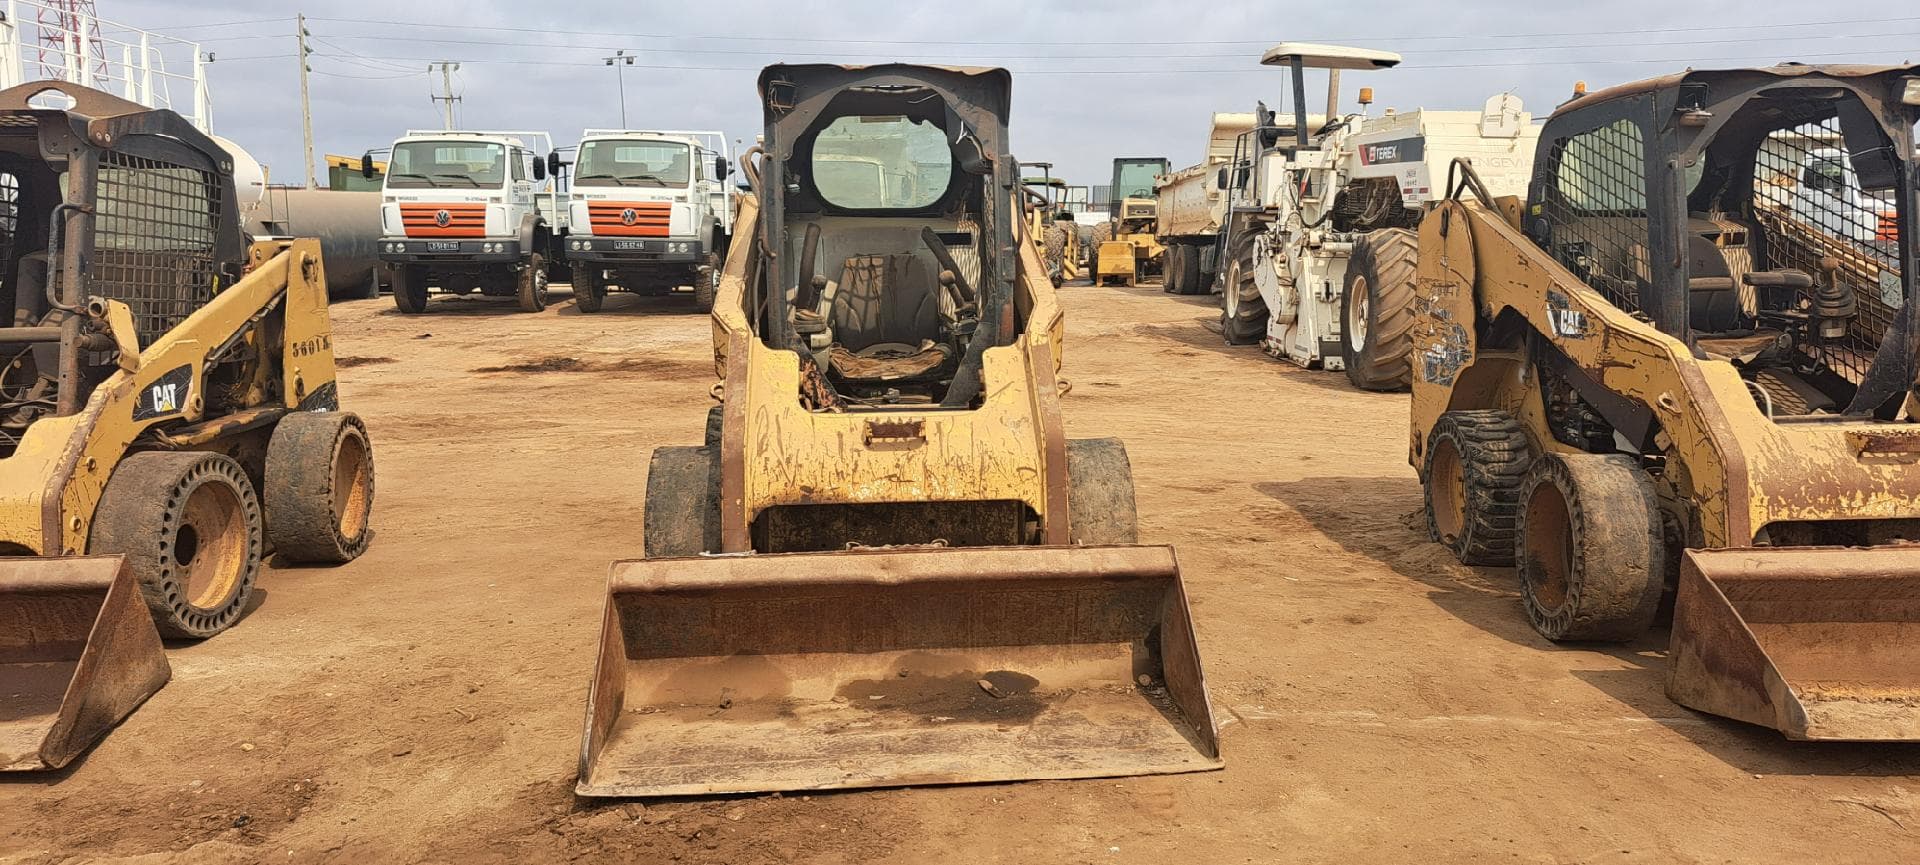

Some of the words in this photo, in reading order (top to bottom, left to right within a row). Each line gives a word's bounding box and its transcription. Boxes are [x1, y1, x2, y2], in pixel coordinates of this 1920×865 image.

[1376, 145, 1397, 160] TEREX
[1560, 310, 1580, 335] CAT
[153, 383, 176, 412] CAT
